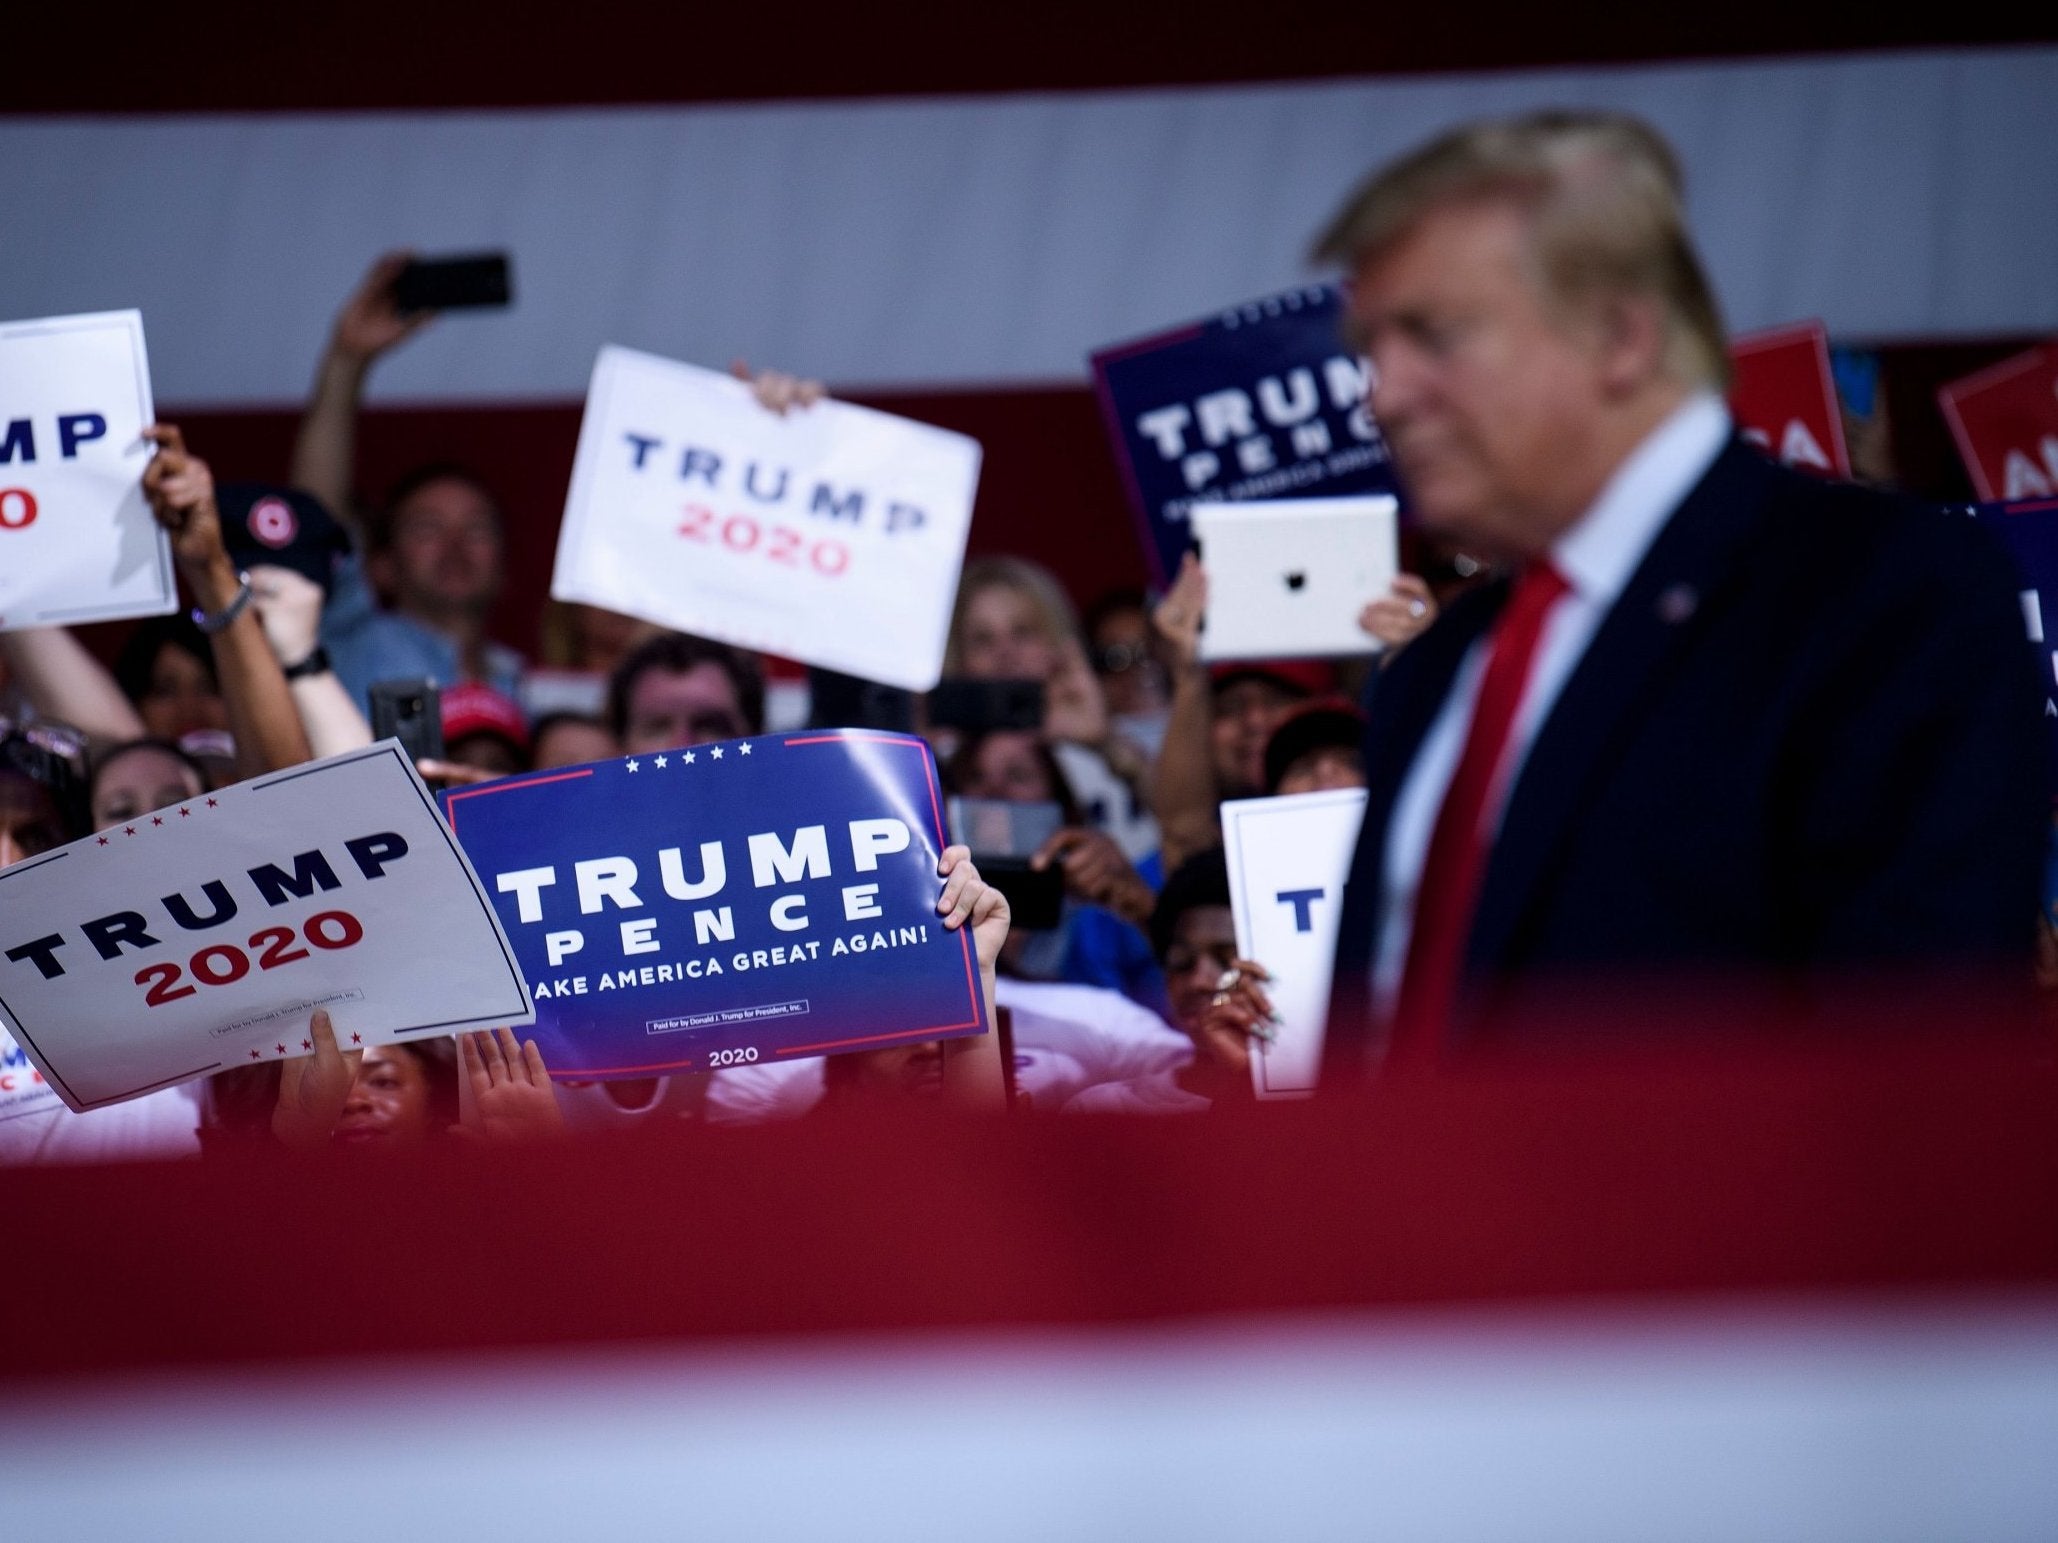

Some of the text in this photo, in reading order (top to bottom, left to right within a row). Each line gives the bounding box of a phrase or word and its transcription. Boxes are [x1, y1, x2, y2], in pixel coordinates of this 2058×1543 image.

[622, 432, 929, 536] TRUMP
[676, 502, 852, 580] 2020
[4, 831, 410, 980] TRUMP
[496, 818, 911, 923] TRUMP
[134, 910, 364, 1008] 2020
[526, 925, 929, 1000] AKE AMERICA GREAT AGAIN!
[545, 883, 883, 967] PENCE
[653, 1020, 668, 1030] Paid
[669, 1020, 680, 1028] for
[680, 1019, 689, 1028] by
[689, 1014, 715, 1025] Donald
[721, 1011, 744, 1020] Trump
[744, 1010, 754, 1018] for
[755, 1005, 789, 1016] President,
[708, 1047, 758, 1067] 2020
